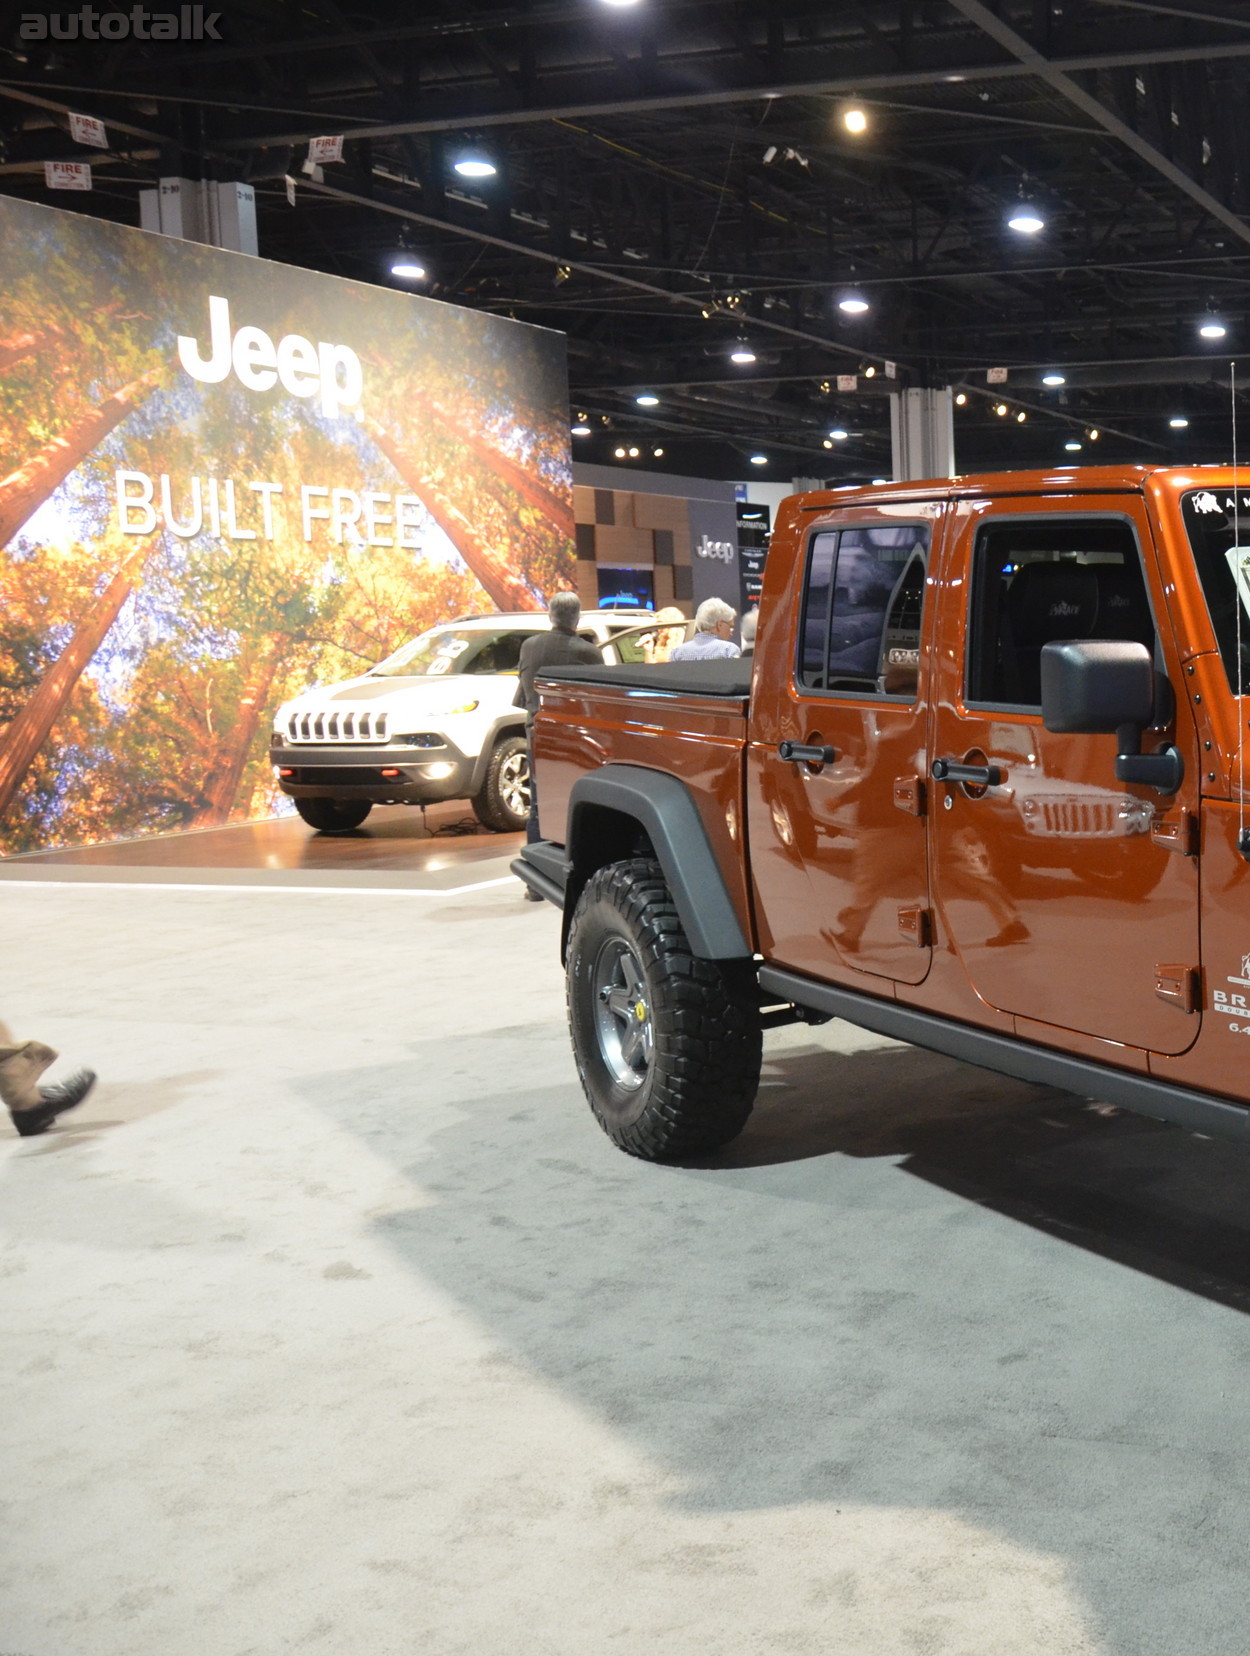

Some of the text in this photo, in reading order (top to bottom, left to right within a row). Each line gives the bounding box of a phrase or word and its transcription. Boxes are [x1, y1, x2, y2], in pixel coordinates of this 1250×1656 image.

[75, 116, 99, 131] FIRE
[315, 138, 337, 148] FIRE
[53, 163, 83, 174] FIRE
[177, 295, 364, 422] Jeep
[115, 469, 425, 551] BUILT FREE
[697, 534, 734, 565] Jeep
